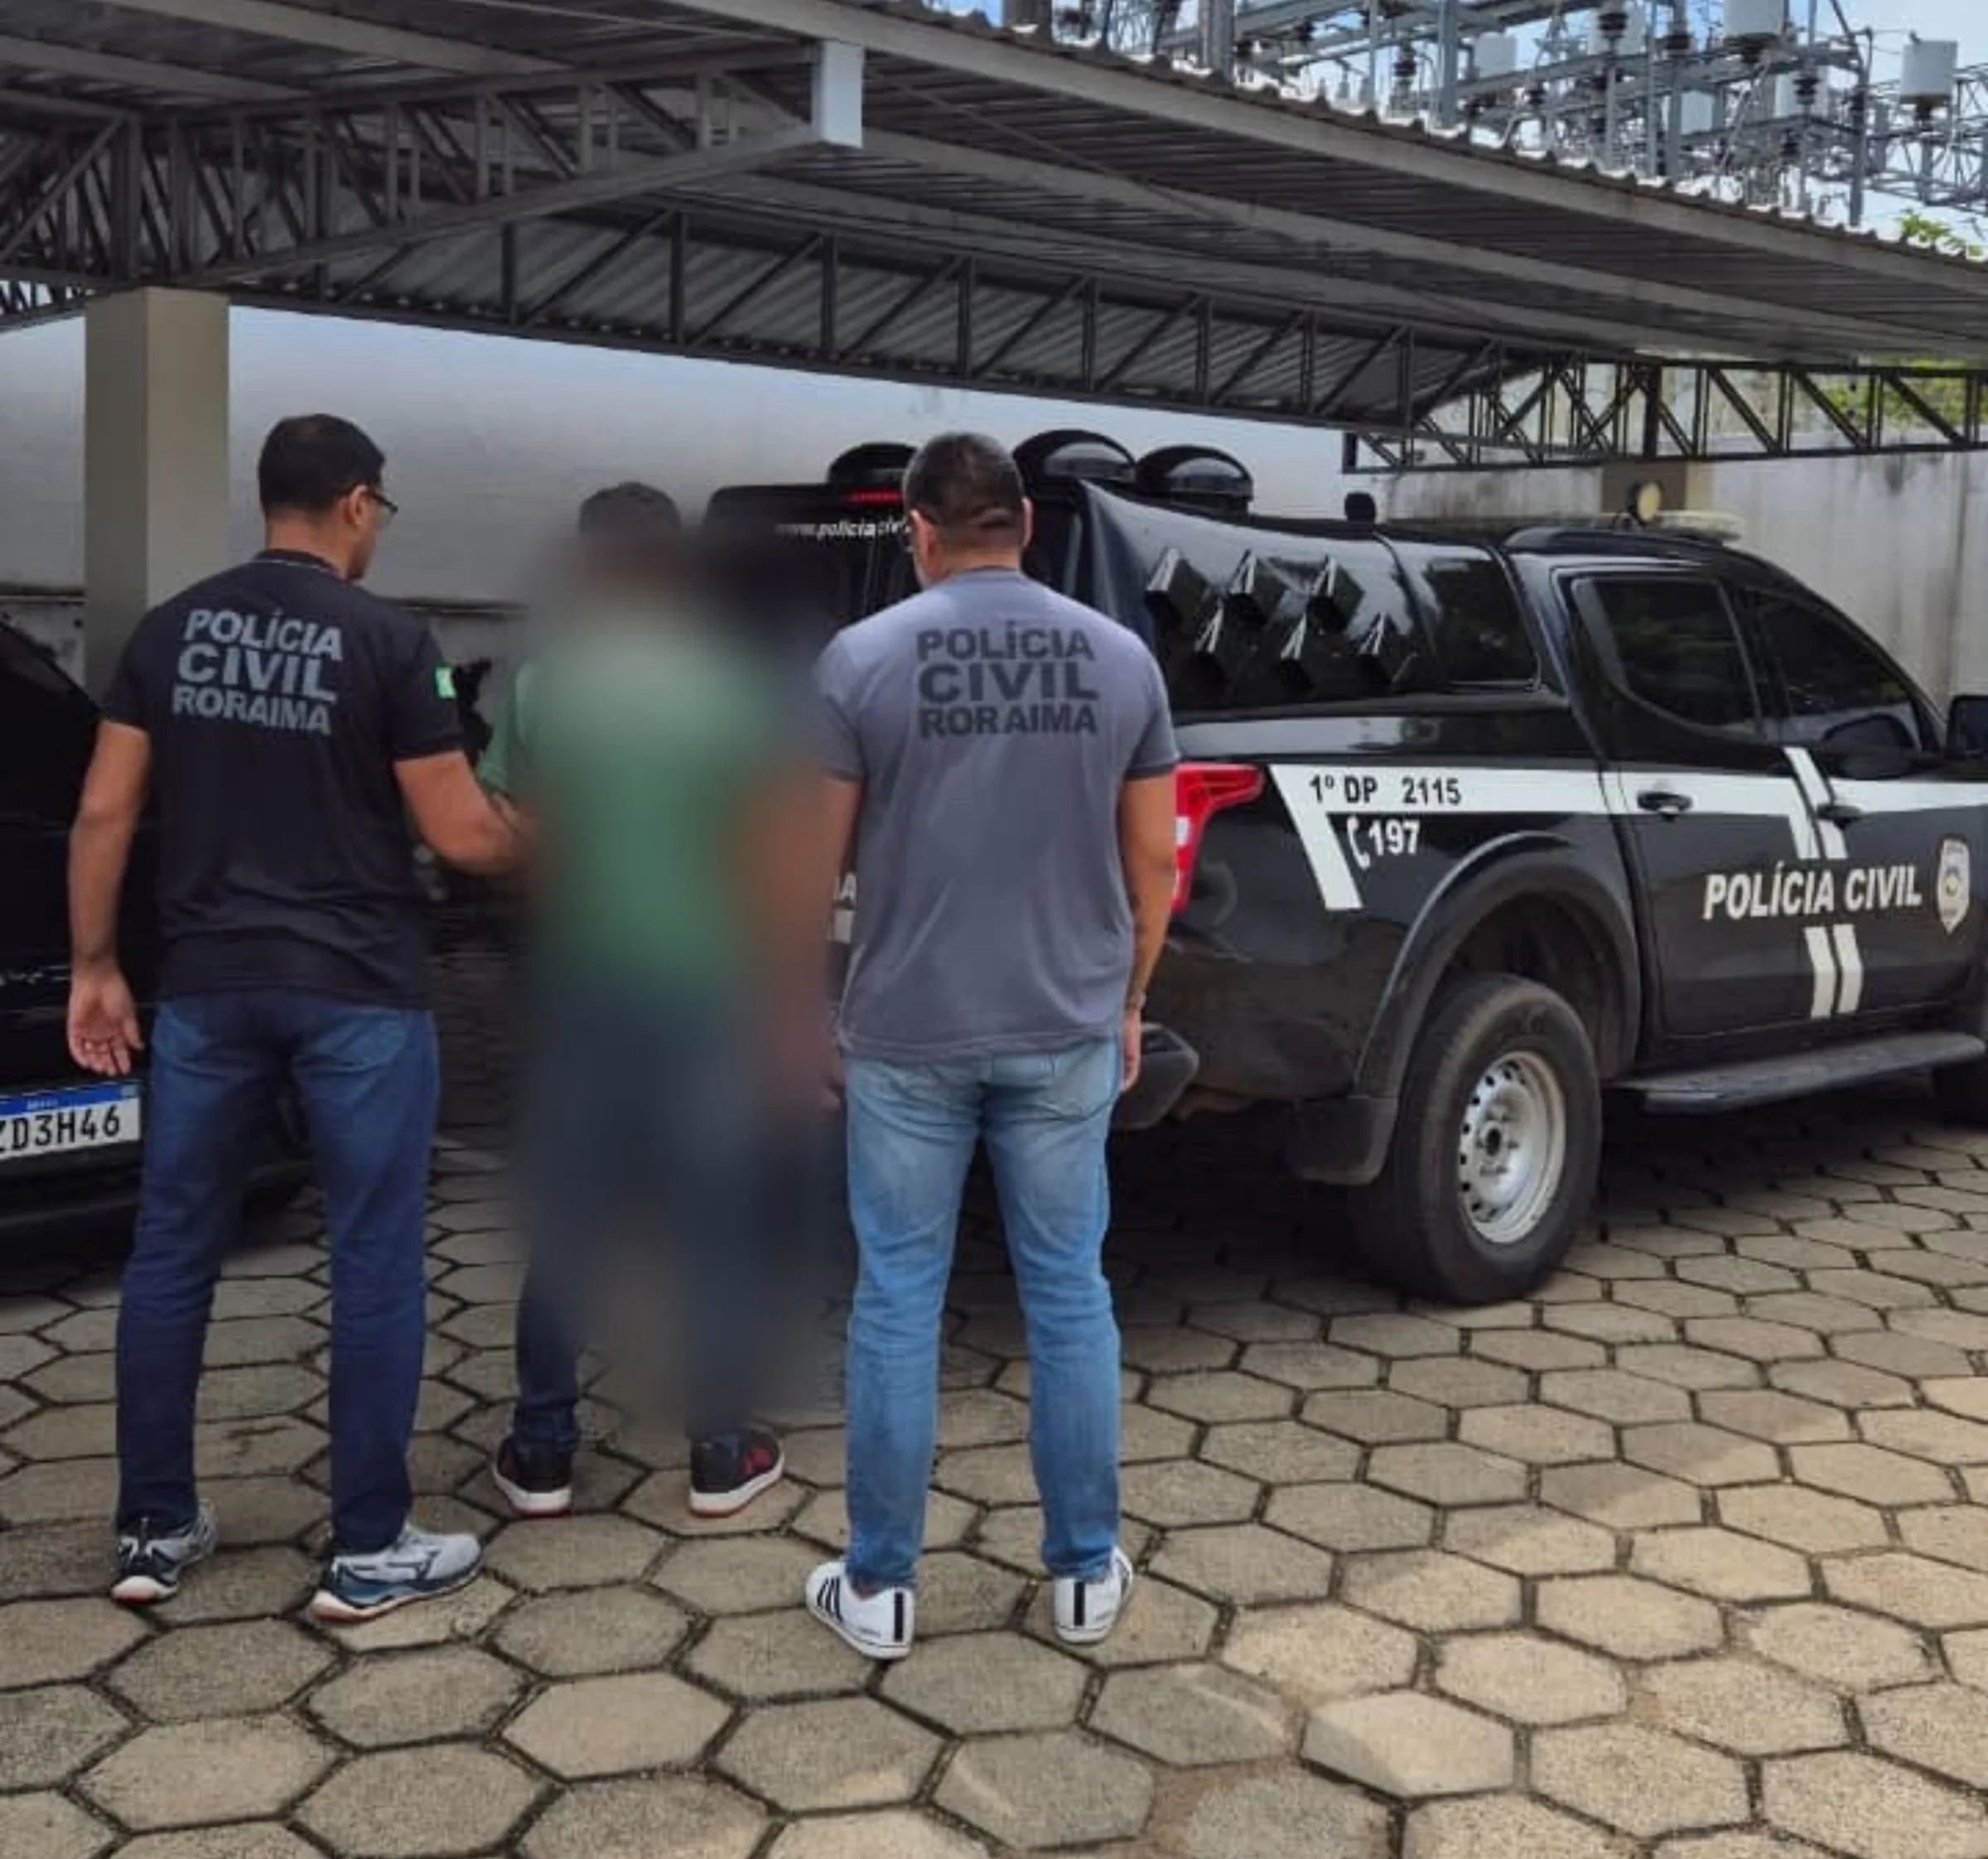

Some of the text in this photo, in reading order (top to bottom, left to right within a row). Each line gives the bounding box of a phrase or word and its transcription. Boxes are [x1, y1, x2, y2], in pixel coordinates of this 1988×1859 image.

[183, 608, 343, 660] POLÍCIA
[916, 621, 1096, 661] POLÍCIA
[177, 642, 336, 703] CIVIL
[919, 662, 1099, 703] CIVIL
[172, 684, 331, 735] RORAIMA
[918, 704, 1098, 739] RORAIMA
[1344, 775, 1378, 804] DP
[1402, 776, 1461, 805] 2115
[1368, 818, 1420, 856] 197
[1703, 861, 1923, 920] POLÍCIA CIVIL
